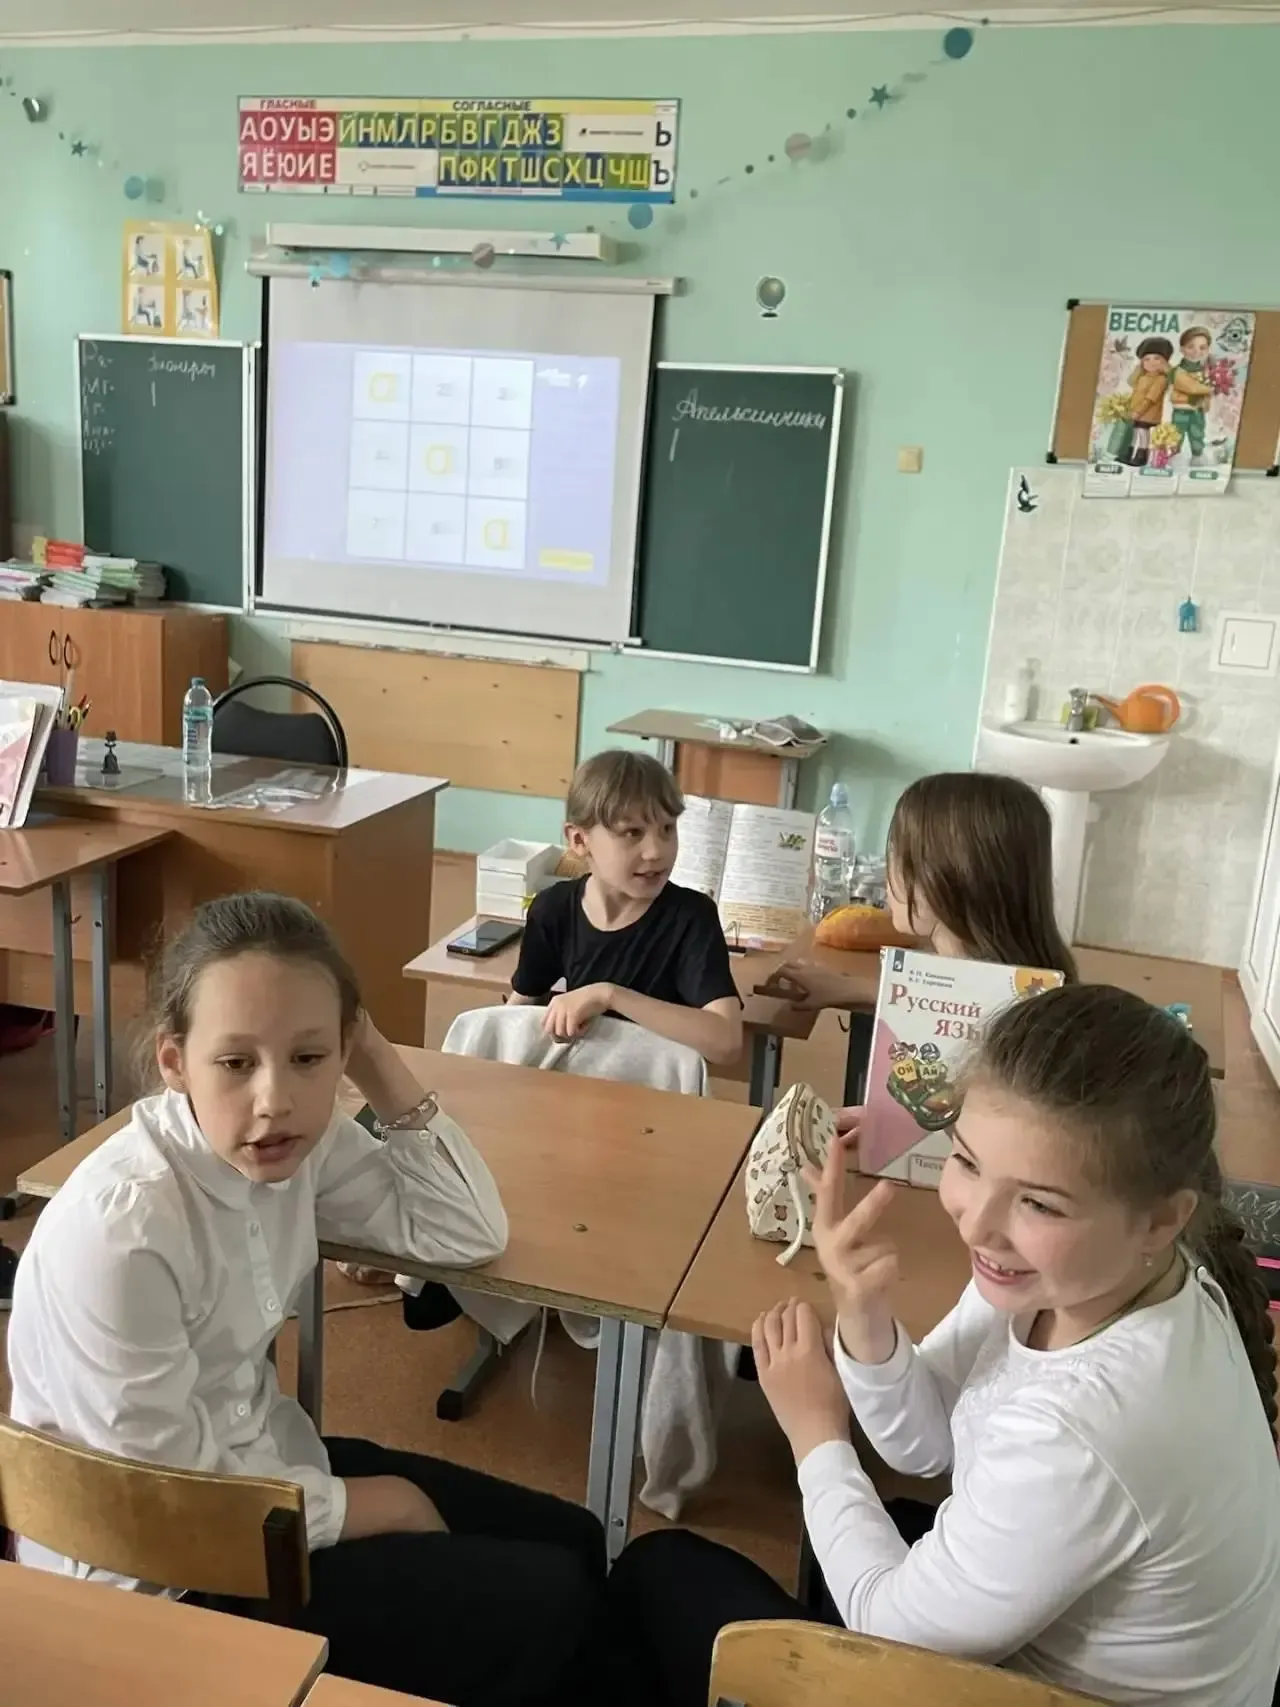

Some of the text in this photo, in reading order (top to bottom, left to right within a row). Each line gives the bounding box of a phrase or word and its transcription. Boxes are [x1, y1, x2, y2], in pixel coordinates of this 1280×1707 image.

[259, 99, 318, 109] ГЛАСНЫЕ
[452, 101, 532, 112] СОГЛАСНЫЕ
[1108, 311, 1181, 334] ВЕСНА
[887, 982, 982, 1019] Русский
[933, 1018, 987, 1042] язы
